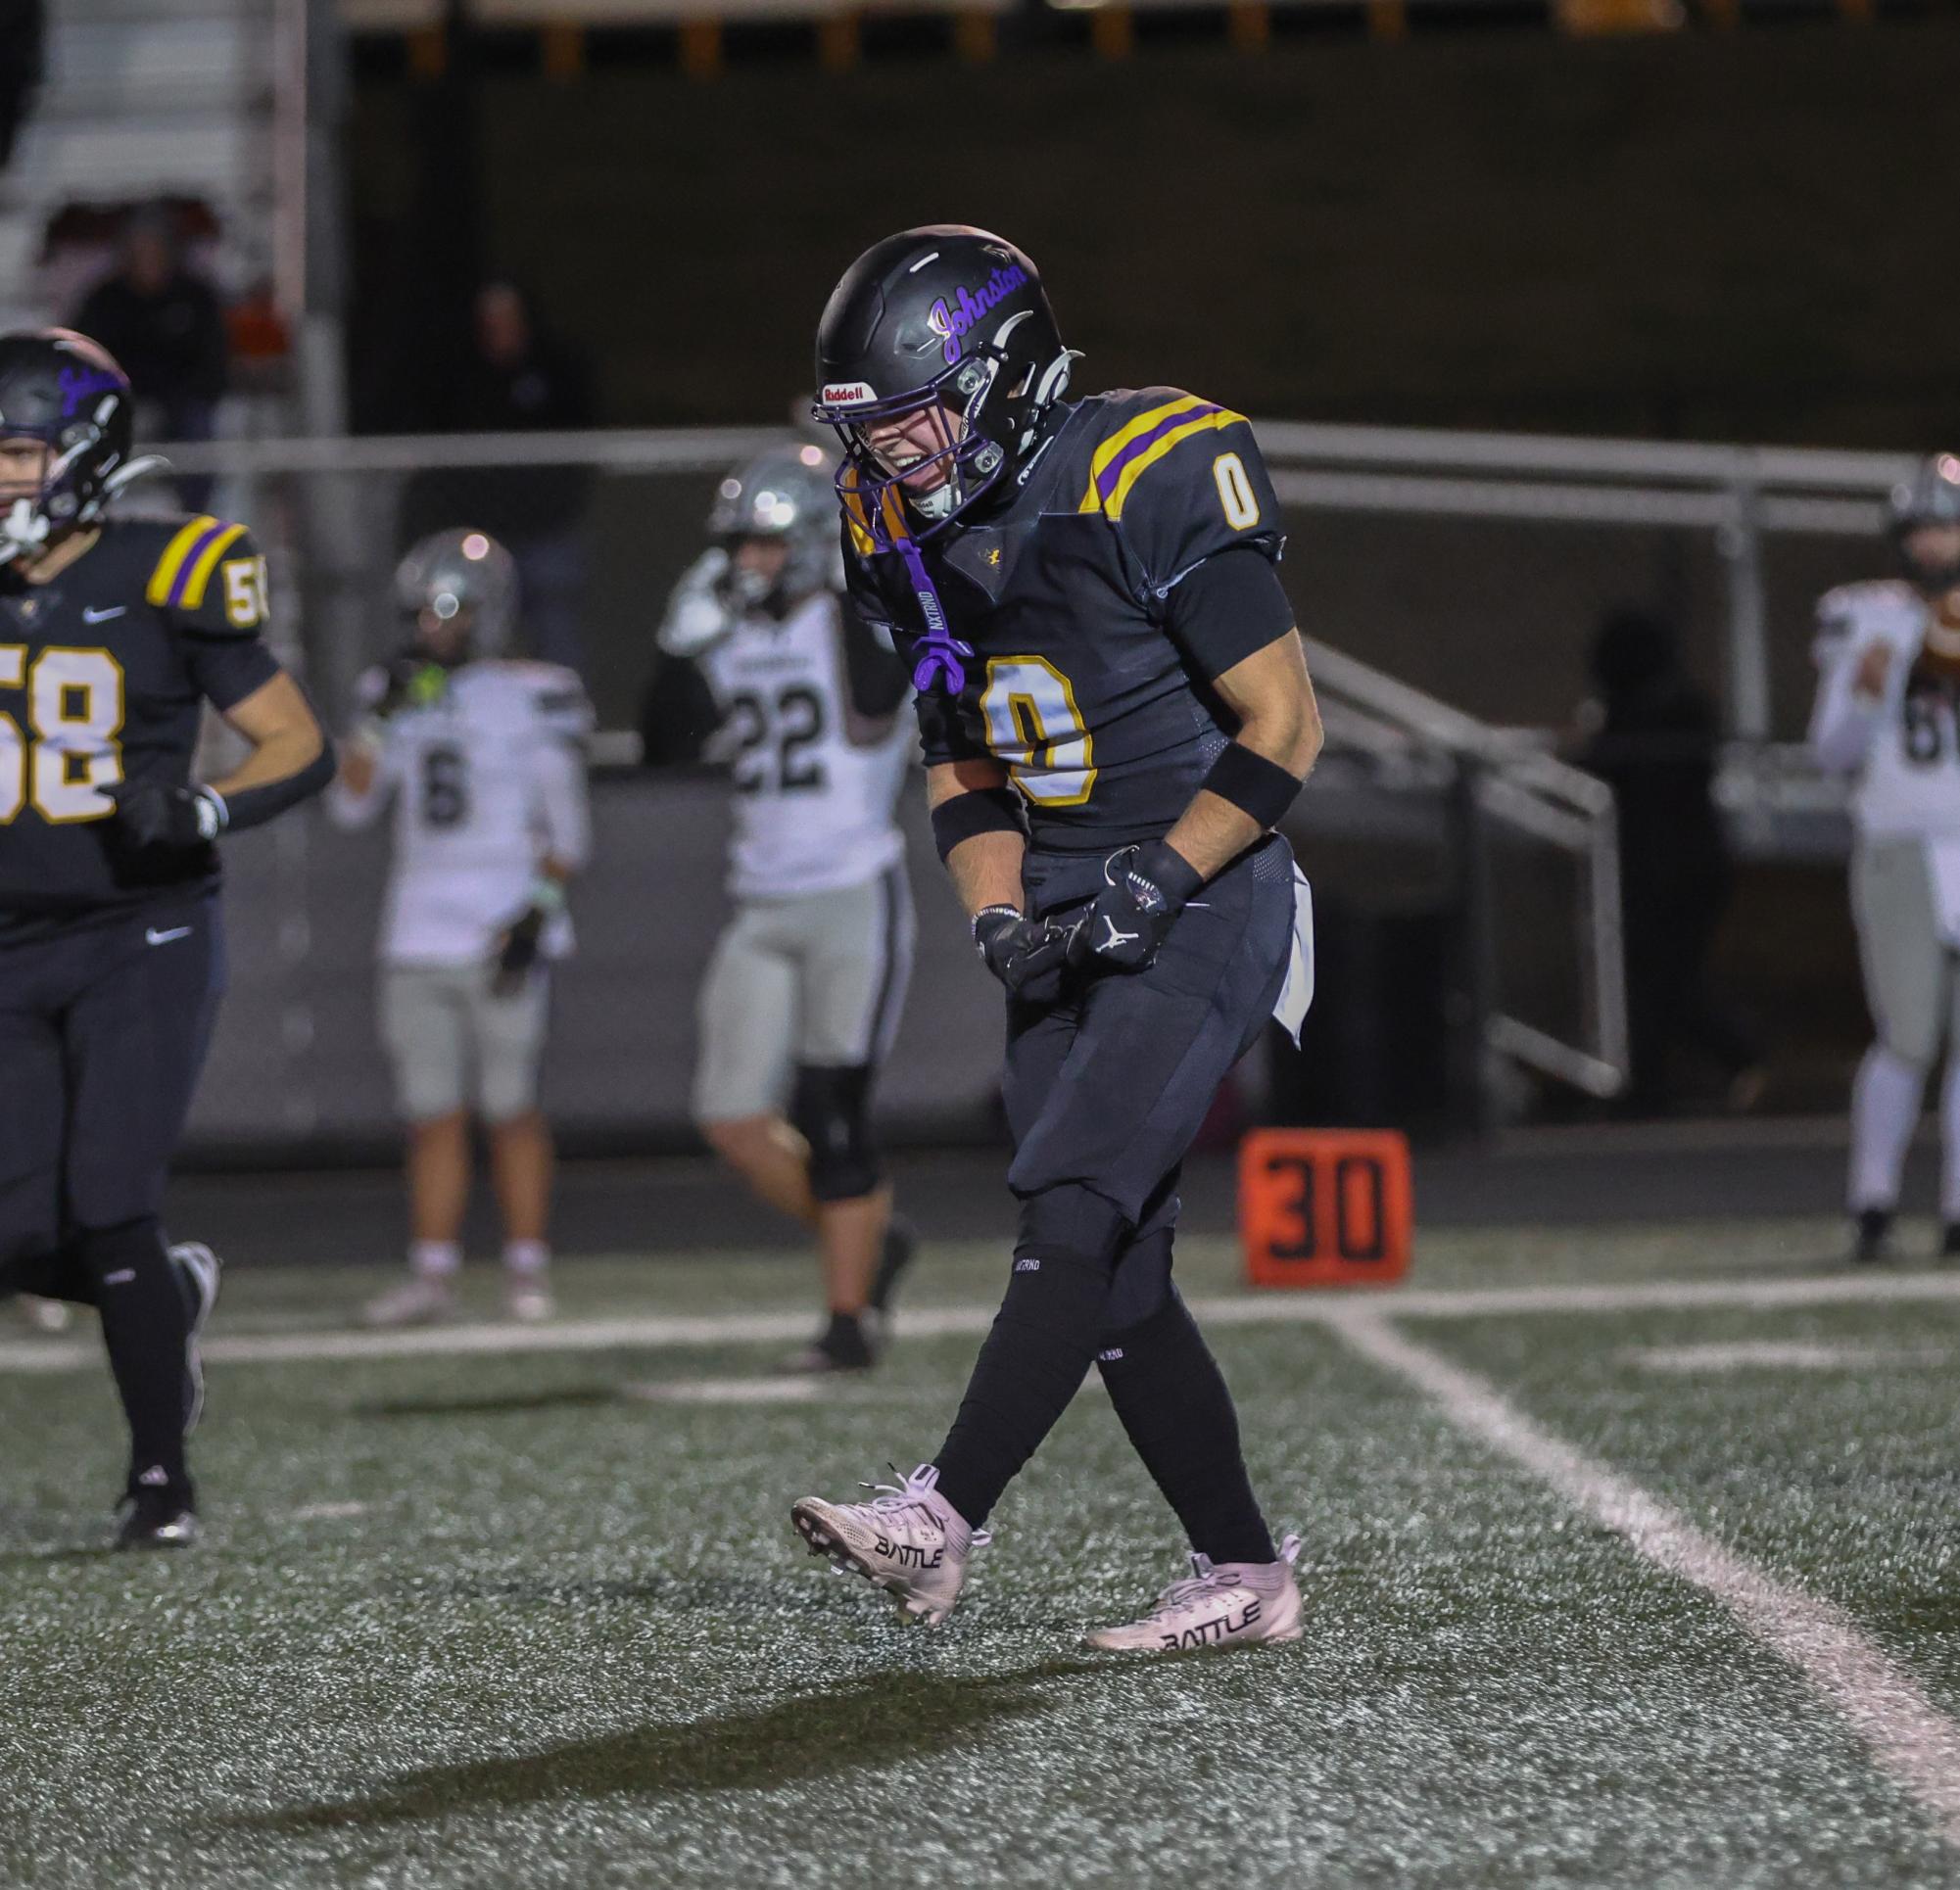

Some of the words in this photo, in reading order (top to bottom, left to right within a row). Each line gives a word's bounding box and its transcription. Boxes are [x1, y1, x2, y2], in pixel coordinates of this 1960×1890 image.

[927, 264, 1028, 365] Johnston
[825, 387, 863, 402] Riddell
[1213, 451, 1261, 531] 0
[918, 591, 944, 631] NXTRND
[729, 685, 826, 795] 22
[980, 655, 1098, 807] 0
[424, 745, 468, 830] 6
[1268, 1154, 1384, 1261] 30
[875, 1533, 945, 1569] BATTLE
